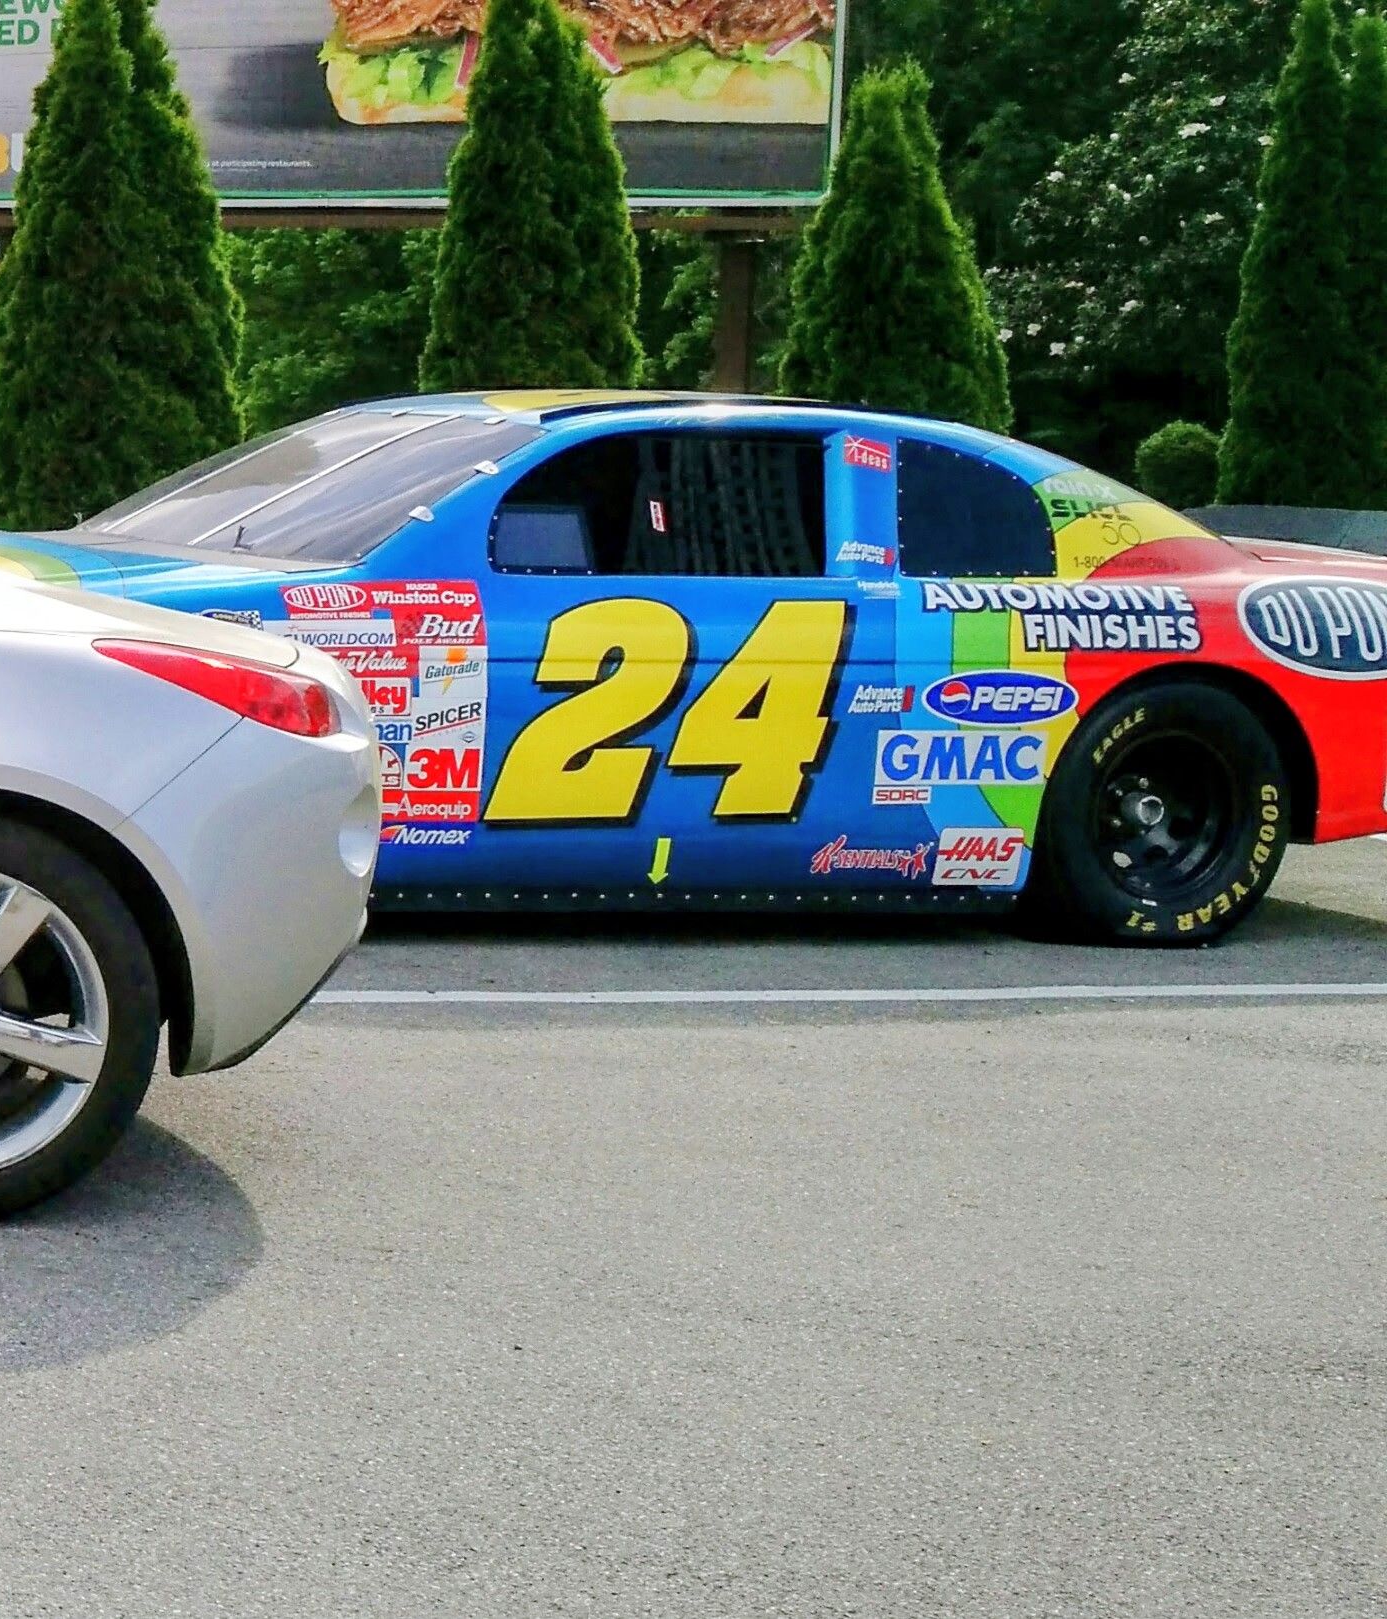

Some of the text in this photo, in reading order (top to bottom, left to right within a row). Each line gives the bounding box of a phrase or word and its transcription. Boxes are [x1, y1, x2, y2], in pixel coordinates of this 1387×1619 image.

[1101, 521, 1142, 545] 50
[314, 584, 360, 609] PONT
[370, 590, 477, 608] Winston Cup
[921, 581, 1195, 613] AUTOMOTIVE
[416, 614, 483, 637] Bud
[1022, 613, 1202, 651] FINISHES
[1257, 585, 1387, 662] DU PON
[301, 632, 395, 646] WORLDCOM
[352, 650, 409, 673] Value
[425, 660, 481, 680] Gatorade
[855, 684, 904, 700] Advance
[971, 686, 1064, 712] PEPSI
[415, 701, 483, 732] SPICER
[482, 597, 849, 826] 24
[1092, 707, 1146, 764] EAGLE
[406, 748, 481, 789] 3M
[881, 733, 1044, 782] GMAC
[395, 792, 473, 820] Aeroquip
[394, 827, 473, 845] Nomex
[938, 836, 1024, 862] HAAS
[940, 868, 1010, 880] CNC
